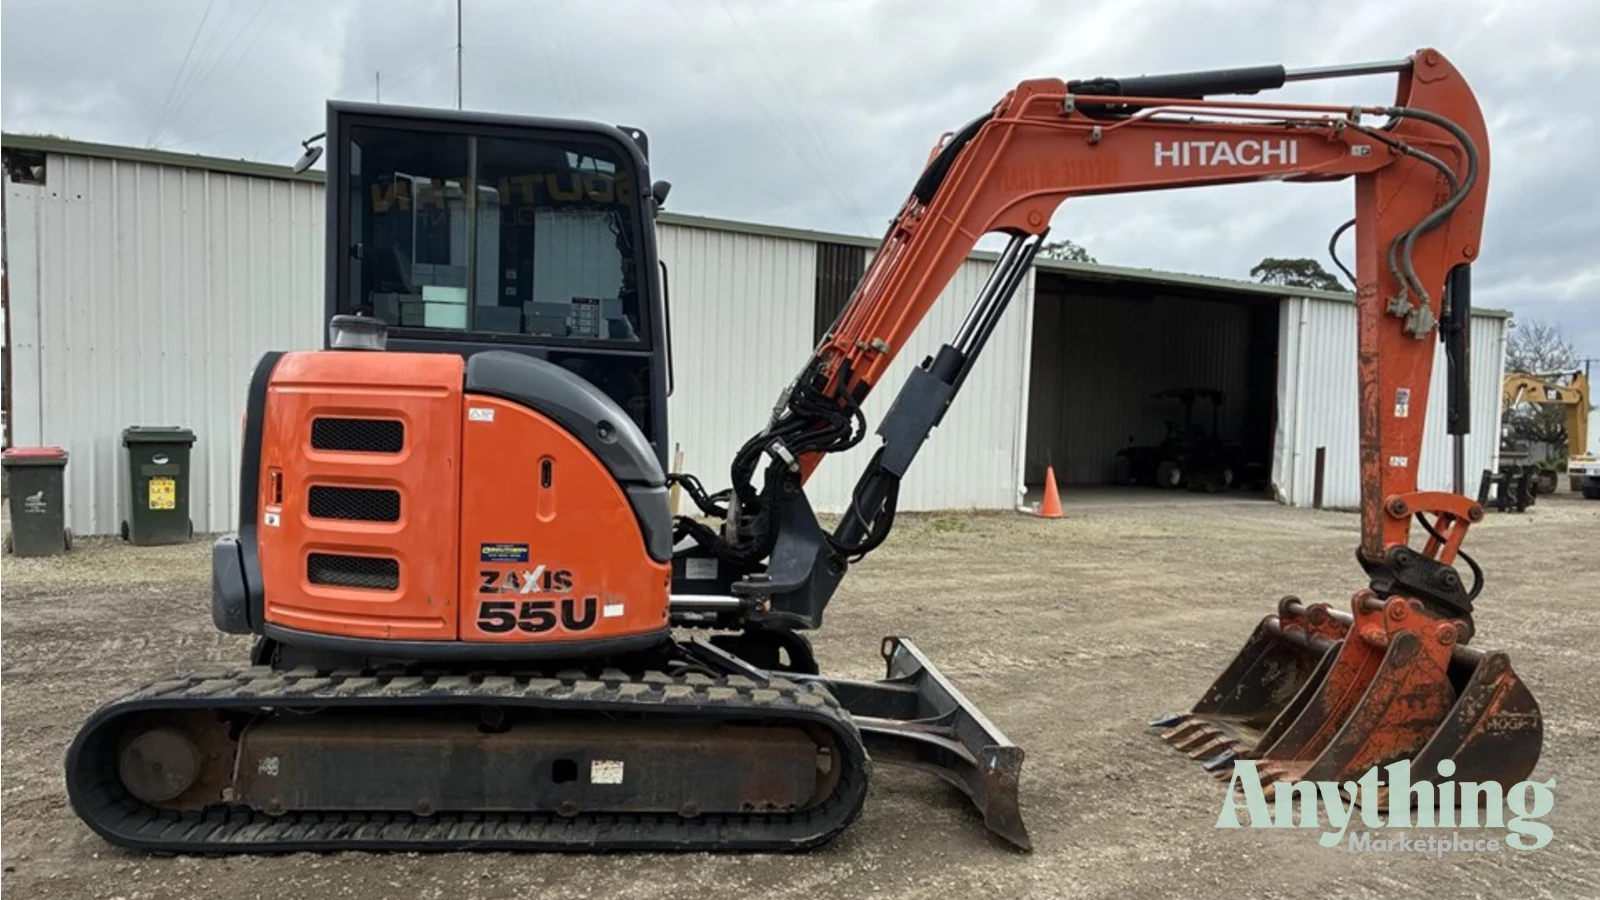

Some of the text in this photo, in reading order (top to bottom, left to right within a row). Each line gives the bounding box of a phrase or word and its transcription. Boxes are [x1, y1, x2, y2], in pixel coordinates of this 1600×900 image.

[1154, 139, 1298, 167] HITACHI
[480, 565, 573, 594] ZAXIS
[477, 598, 598, 634] 55U
